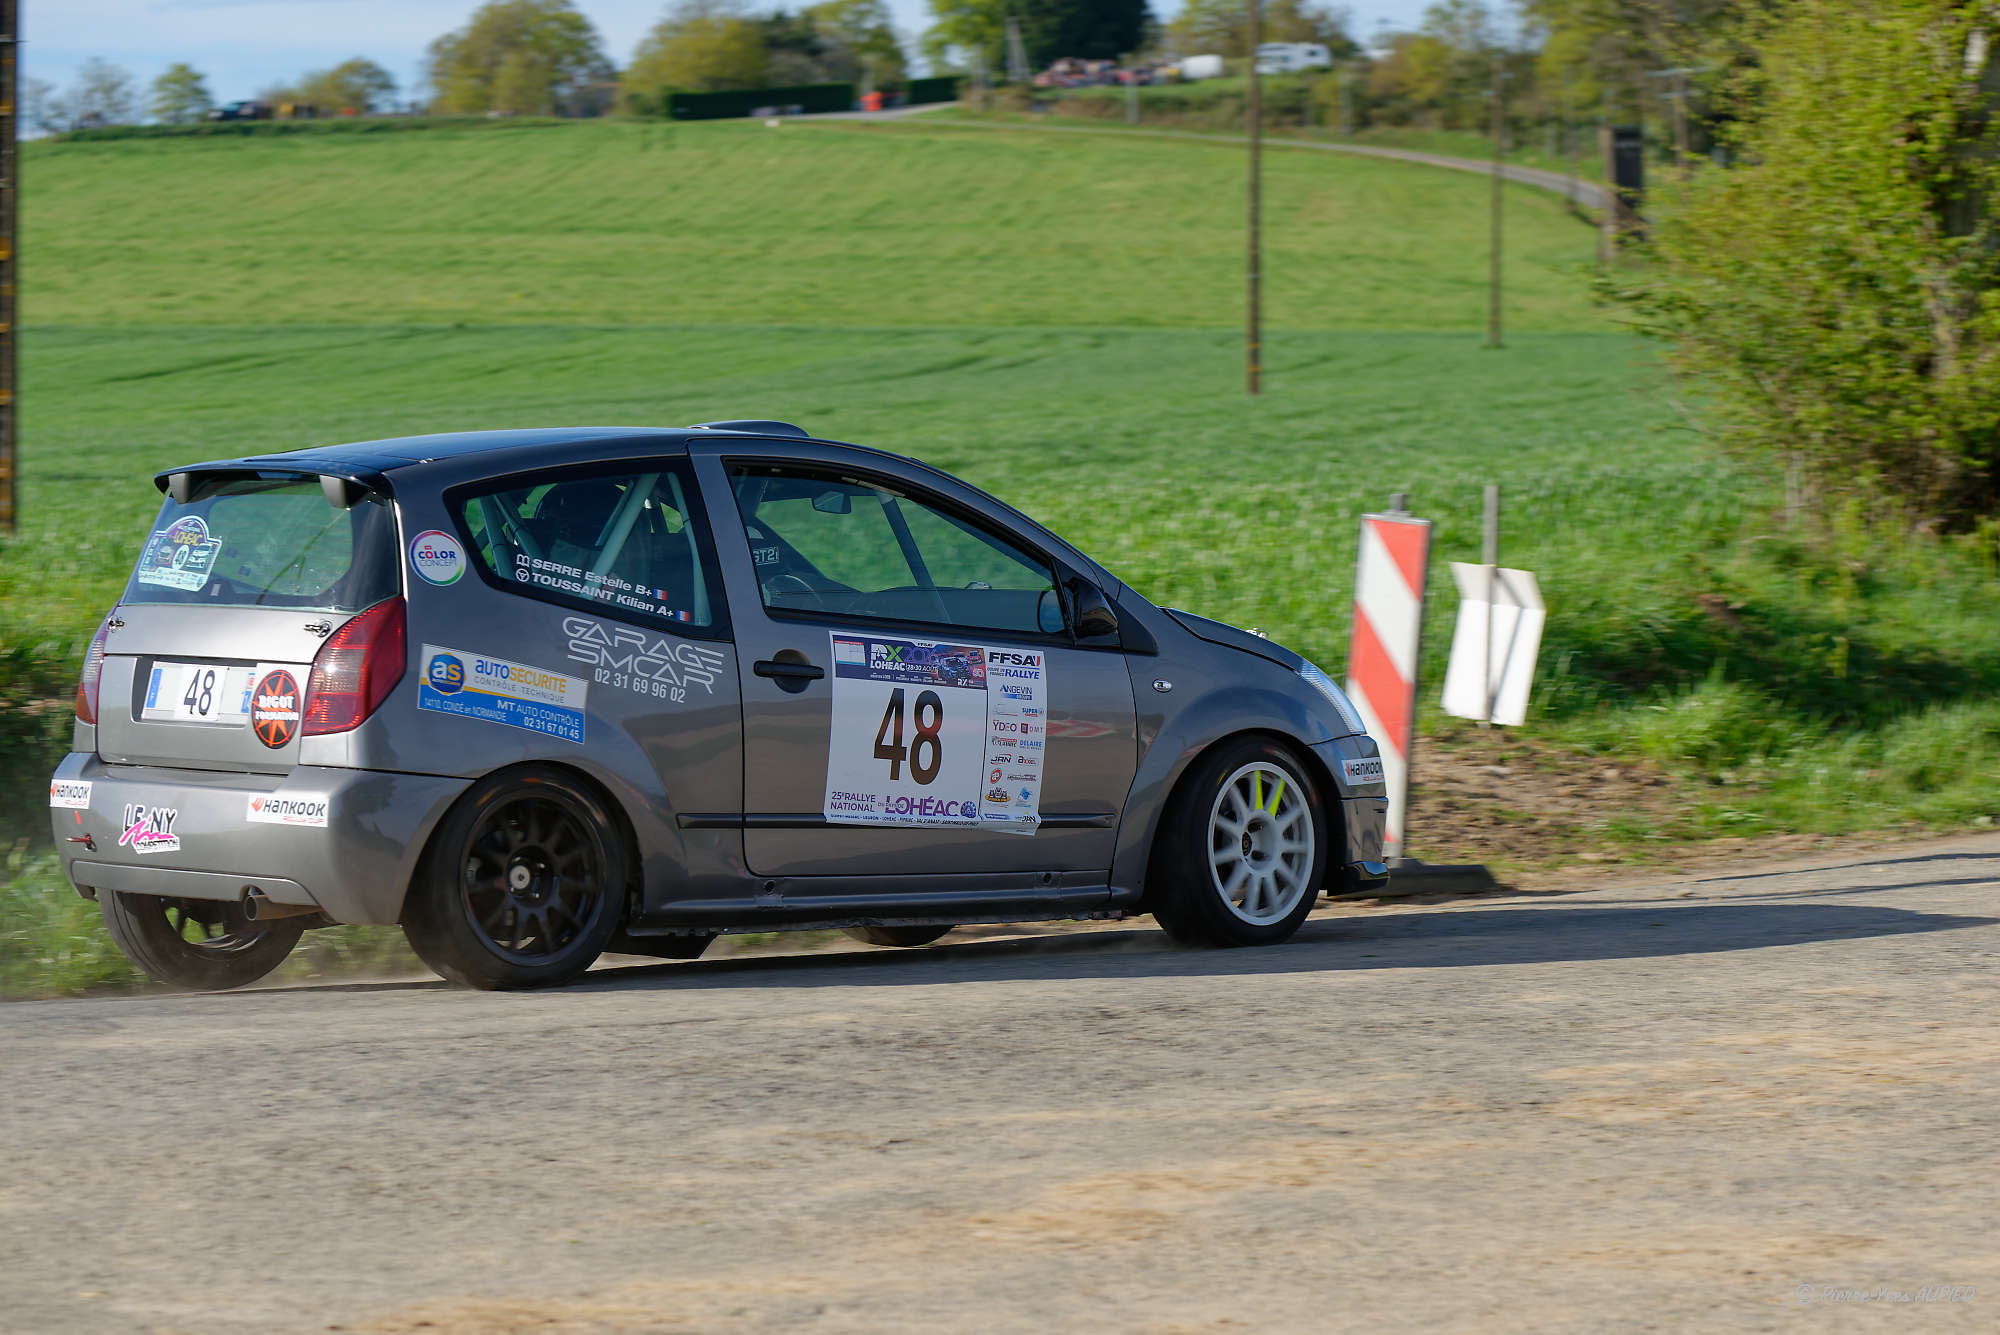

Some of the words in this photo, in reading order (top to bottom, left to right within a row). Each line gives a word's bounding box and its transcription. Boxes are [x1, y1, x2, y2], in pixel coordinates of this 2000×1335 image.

[418, 550, 456, 559] COLOR
[532, 558, 582, 578] SERRE
[584, 570, 632, 592] Estelle
[635, 584, 652, 598] B+
[532, 572, 614, 601] TOUSSAINT
[616, 594, 654, 613] Kilian
[656, 605, 674, 618] A+
[562, 616, 725, 674] GARAGE
[567, 639, 714, 695] SMCAR
[870, 660, 906, 672] LOHEAC
[988, 652, 1036, 666] FFSA
[432, 661, 461, 681] as
[1005, 669, 1040, 680] RALLYE
[184, 669, 216, 716] 48
[521, 686, 564, 704] TECHNIQUE
[594, 668, 610, 685] 02
[613, 673, 628, 689] 31
[633, 678, 648, 694] 69
[651, 683, 666, 699] 96
[670, 687, 686, 704] 02
[1000, 684, 1032, 694] ANGEVIN
[258, 695, 294, 709] BIGOT
[497, 700, 516, 712] MT
[516, 704, 538, 717] AUTO
[540, 709, 580, 728] CONTRÔLE
[524, 716, 534, 728] 02
[536, 719, 545, 730] 31
[547, 721, 556, 733] 67
[558, 724, 568, 736] 01
[569, 728, 580, 740] 45
[873, 688, 944, 786] 48
[830, 802, 875, 813] NATIONAL
[844, 792, 876, 803] RALLYE
[885, 795, 960, 816] LOHÉAC
[150, 809, 176, 834] NY
